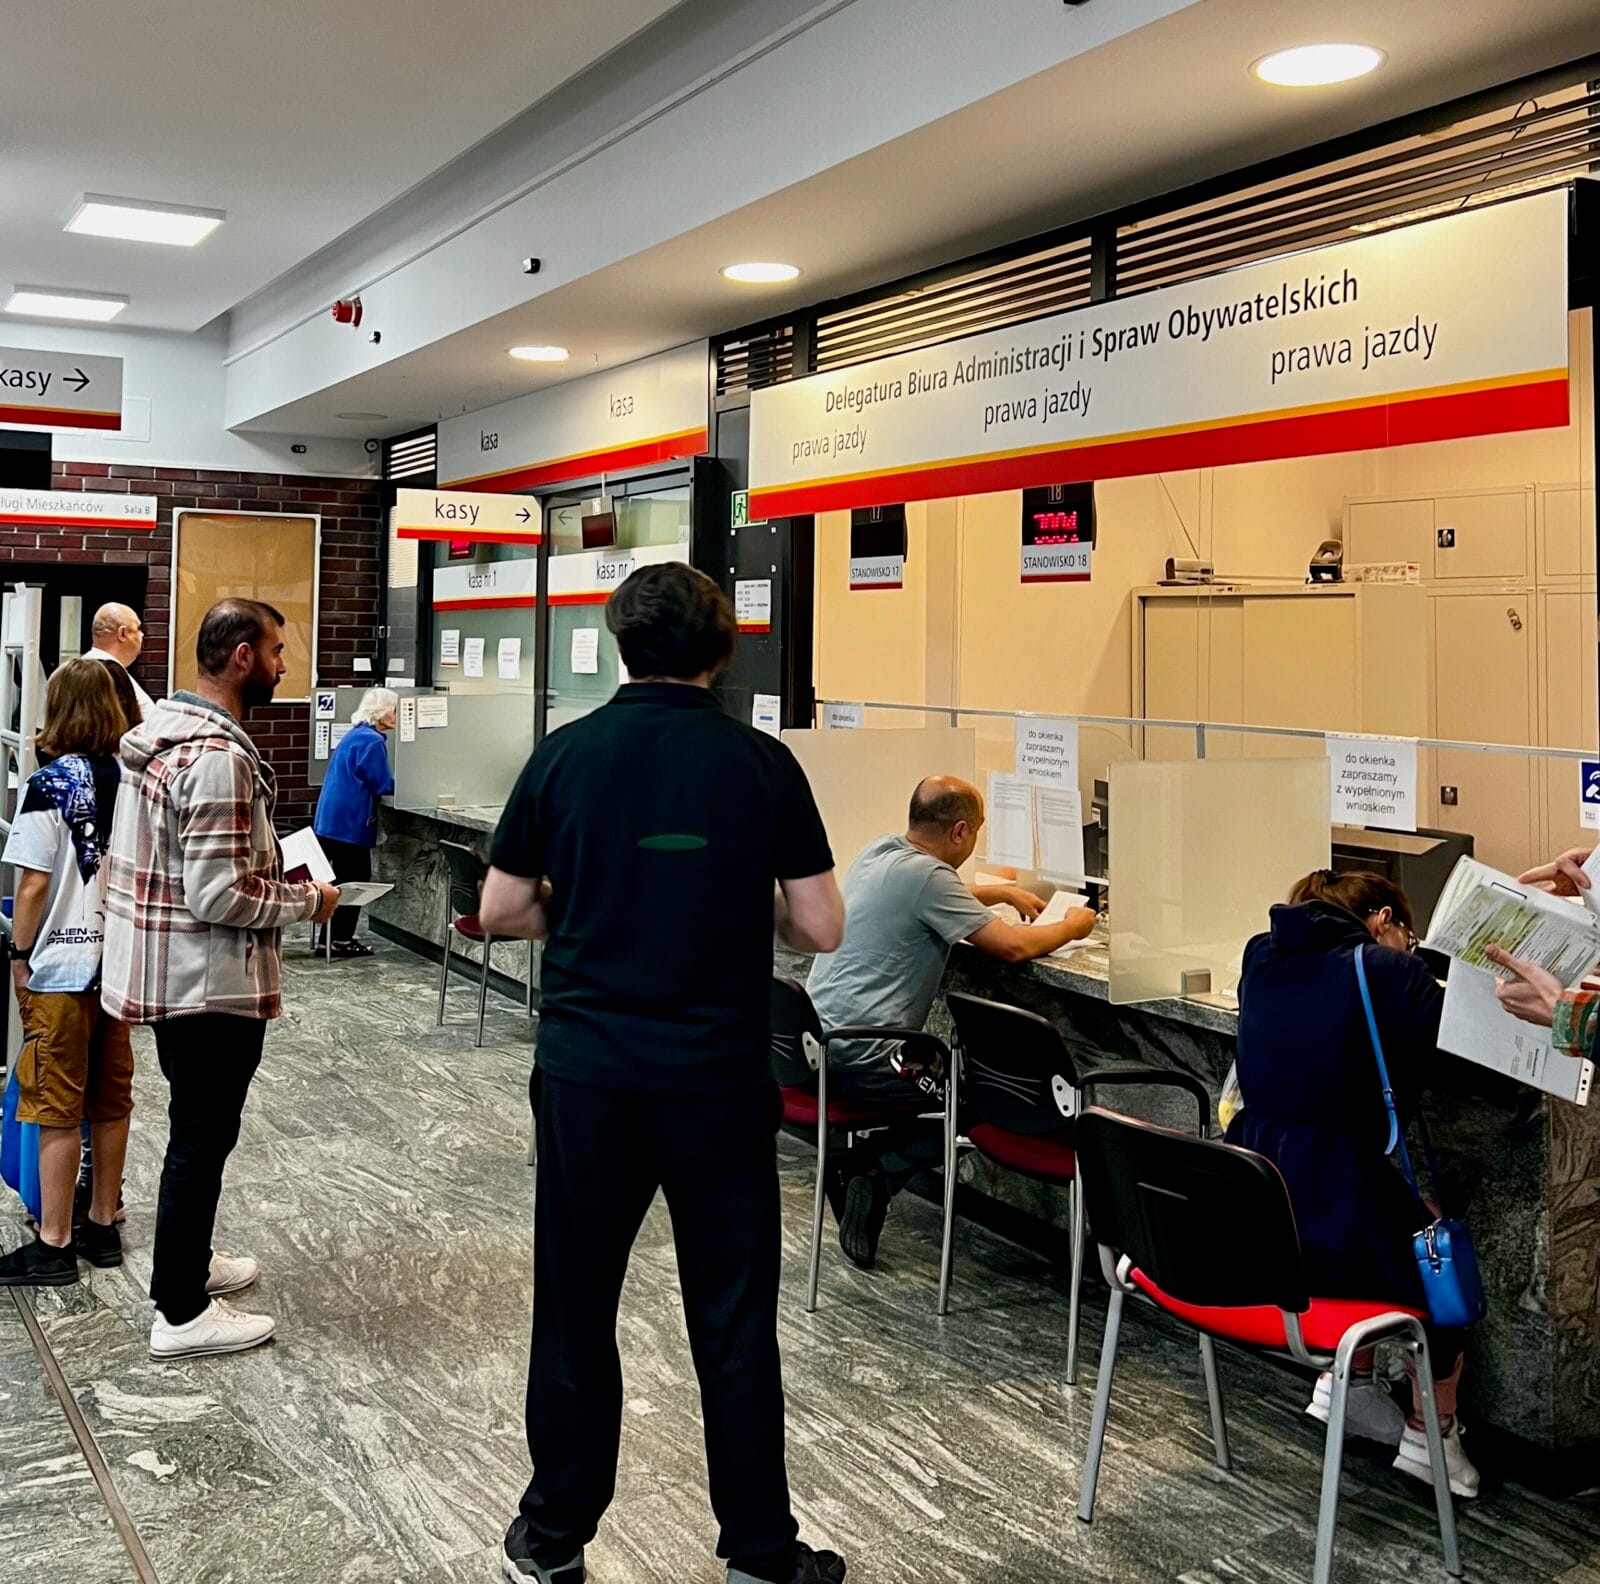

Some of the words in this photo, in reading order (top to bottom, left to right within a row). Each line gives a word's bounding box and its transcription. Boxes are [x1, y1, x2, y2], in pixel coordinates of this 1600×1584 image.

[825, 379, 902, 413] Delegatura
[908, 368, 948, 396] Biura
[953, 337, 1072, 387] Administracji
[1079, 330, 1085, 360] i
[1091, 320, 1160, 362] Spraw
[1168, 268, 1358, 342] Obywatelskich
[1271, 338, 1352, 385] prawa
[1360, 314, 1438, 370] jazdy
[610, 393, 634, 418] kasa
[984, 397, 1037, 432] prawa
[1042, 380, 1093, 422] jazdy
[480, 430, 498, 451] kasa
[792, 435, 830, 464] prawa
[833, 425, 867, 458] jazdy
[27, 498, 104, 513] Mieszkańców
[124, 504, 142, 514] Sala
[435, 496, 480, 525] kasy
[1024, 555, 1075, 568] STANOWISKO
[1078, 554, 1087, 566] 18
[597, 560, 615, 580] kasa
[618, 563, 628, 578] nr
[851, 566, 891, 578] STANOWISKO
[892, 565, 900, 576] 17
[468, 571, 482, 588] kasa
[1029, 730, 1036, 738] do
[1026, 743, 1064, 756] zapraszamy
[1345, 753, 1357, 764] do
[1359, 754, 1396, 767] okienka
[1341, 769, 1398, 785] zapraszamy
[1336, 785, 1342, 793] z
[1345, 785, 1405, 801] wypełnionym
[1346, 801, 1395, 815] wnioskiem
[48, 928, 88, 938] ALIEN
